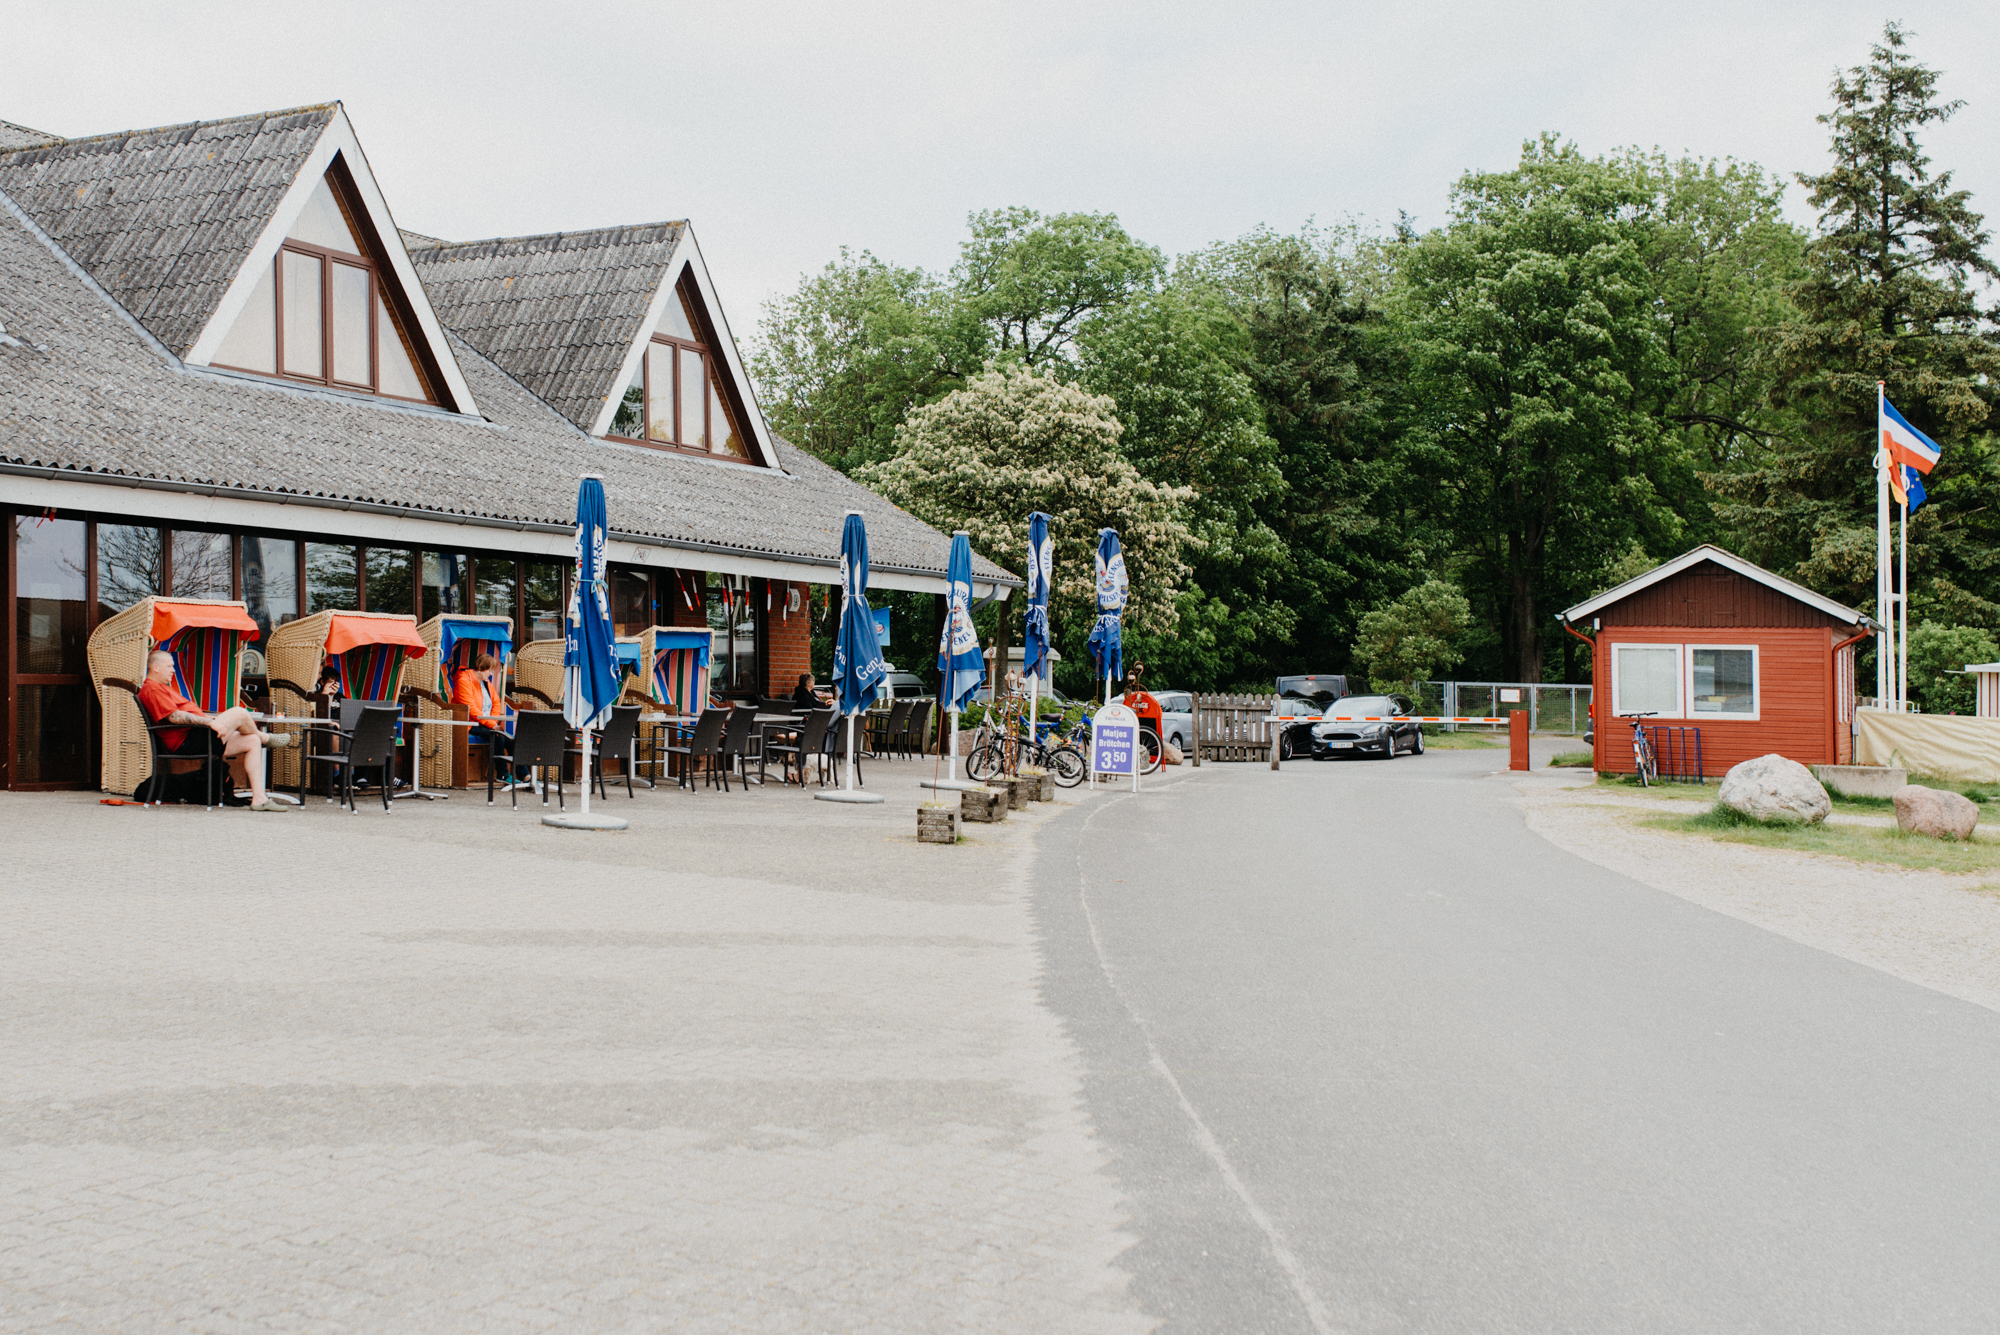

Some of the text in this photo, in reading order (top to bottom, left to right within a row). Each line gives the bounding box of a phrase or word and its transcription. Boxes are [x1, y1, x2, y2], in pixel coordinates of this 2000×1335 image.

[1102, 729, 1128, 739] Matjes
[1098, 738, 1131, 748] Brötchen
[1101, 751, 1127, 769] 3.50
